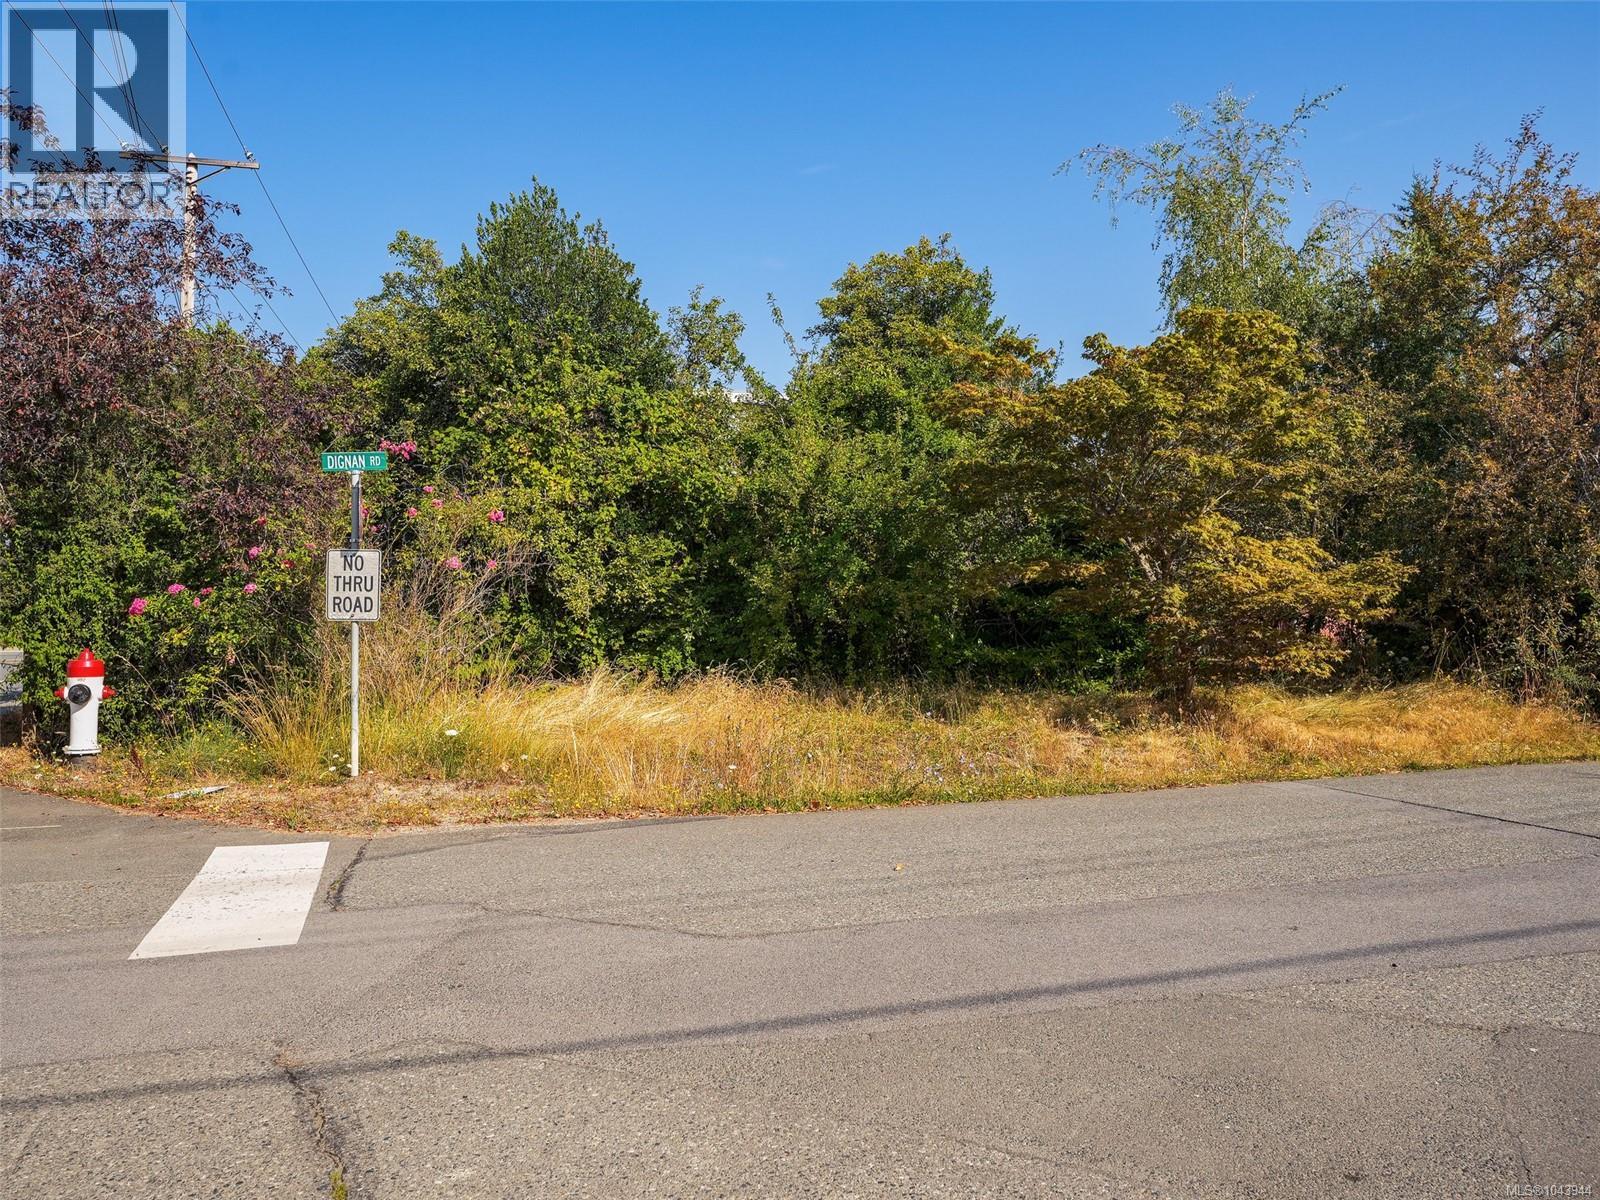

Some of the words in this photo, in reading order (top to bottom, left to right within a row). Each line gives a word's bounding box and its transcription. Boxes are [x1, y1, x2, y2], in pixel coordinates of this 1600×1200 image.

[327, 454, 366, 469] DIGNAN
[369, 456, 381, 466] RD
[343, 555, 364, 572] NO
[333, 575, 374, 592] THRU
[332, 596, 374, 613] ROAD
